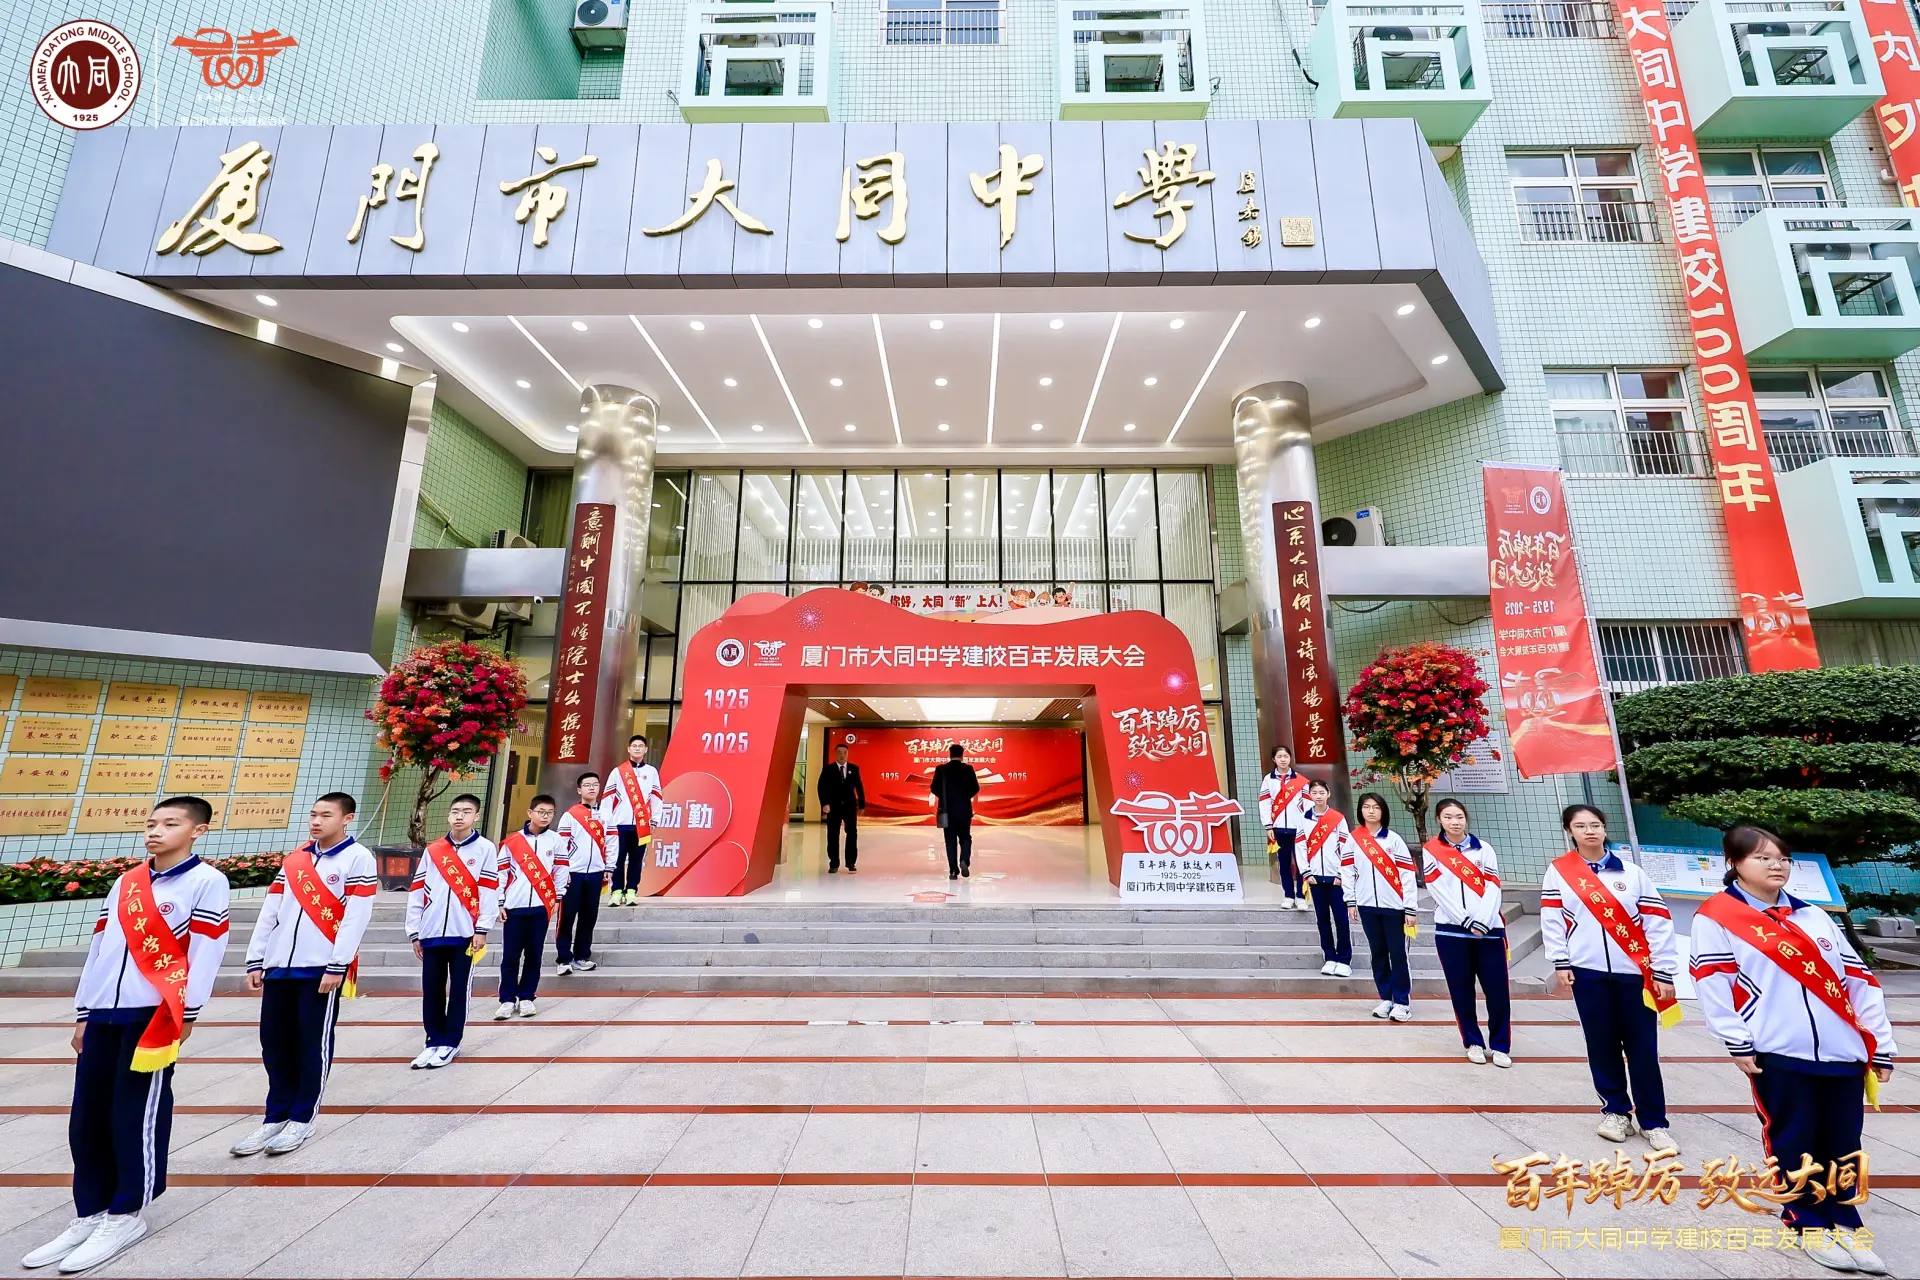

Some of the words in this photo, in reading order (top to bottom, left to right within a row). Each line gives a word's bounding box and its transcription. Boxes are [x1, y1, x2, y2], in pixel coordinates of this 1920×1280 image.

[800, 645, 1145, 668] 厦门市大同中学建校百年发展大会
[120, 694, 166, 704] 先进单位
[190, 698, 240, 709] 巾帼文明岗
[704, 688, 749, 710] 1925
[1112, 704, 1201, 735] 百年踔厉
[26, 731, 78, 740] 基地学校
[255, 737, 295, 745] 文明校园
[702, 732, 749, 754] 2025
[1127, 731, 1208, 761] 致远大同
[16, 769, 70, 777] 平安校园
[881, 772, 899, 780] 1925
[1008, 772, 1027, 780] 2025
[85, 807, 148, 817] 厦门市智慧校园
[1138, 860, 1177, 869] 百年踔厉
[1182, 860, 1222, 871] 致远大同
[1126, 881, 1236, 892] 厦门市大同中学建校百年
